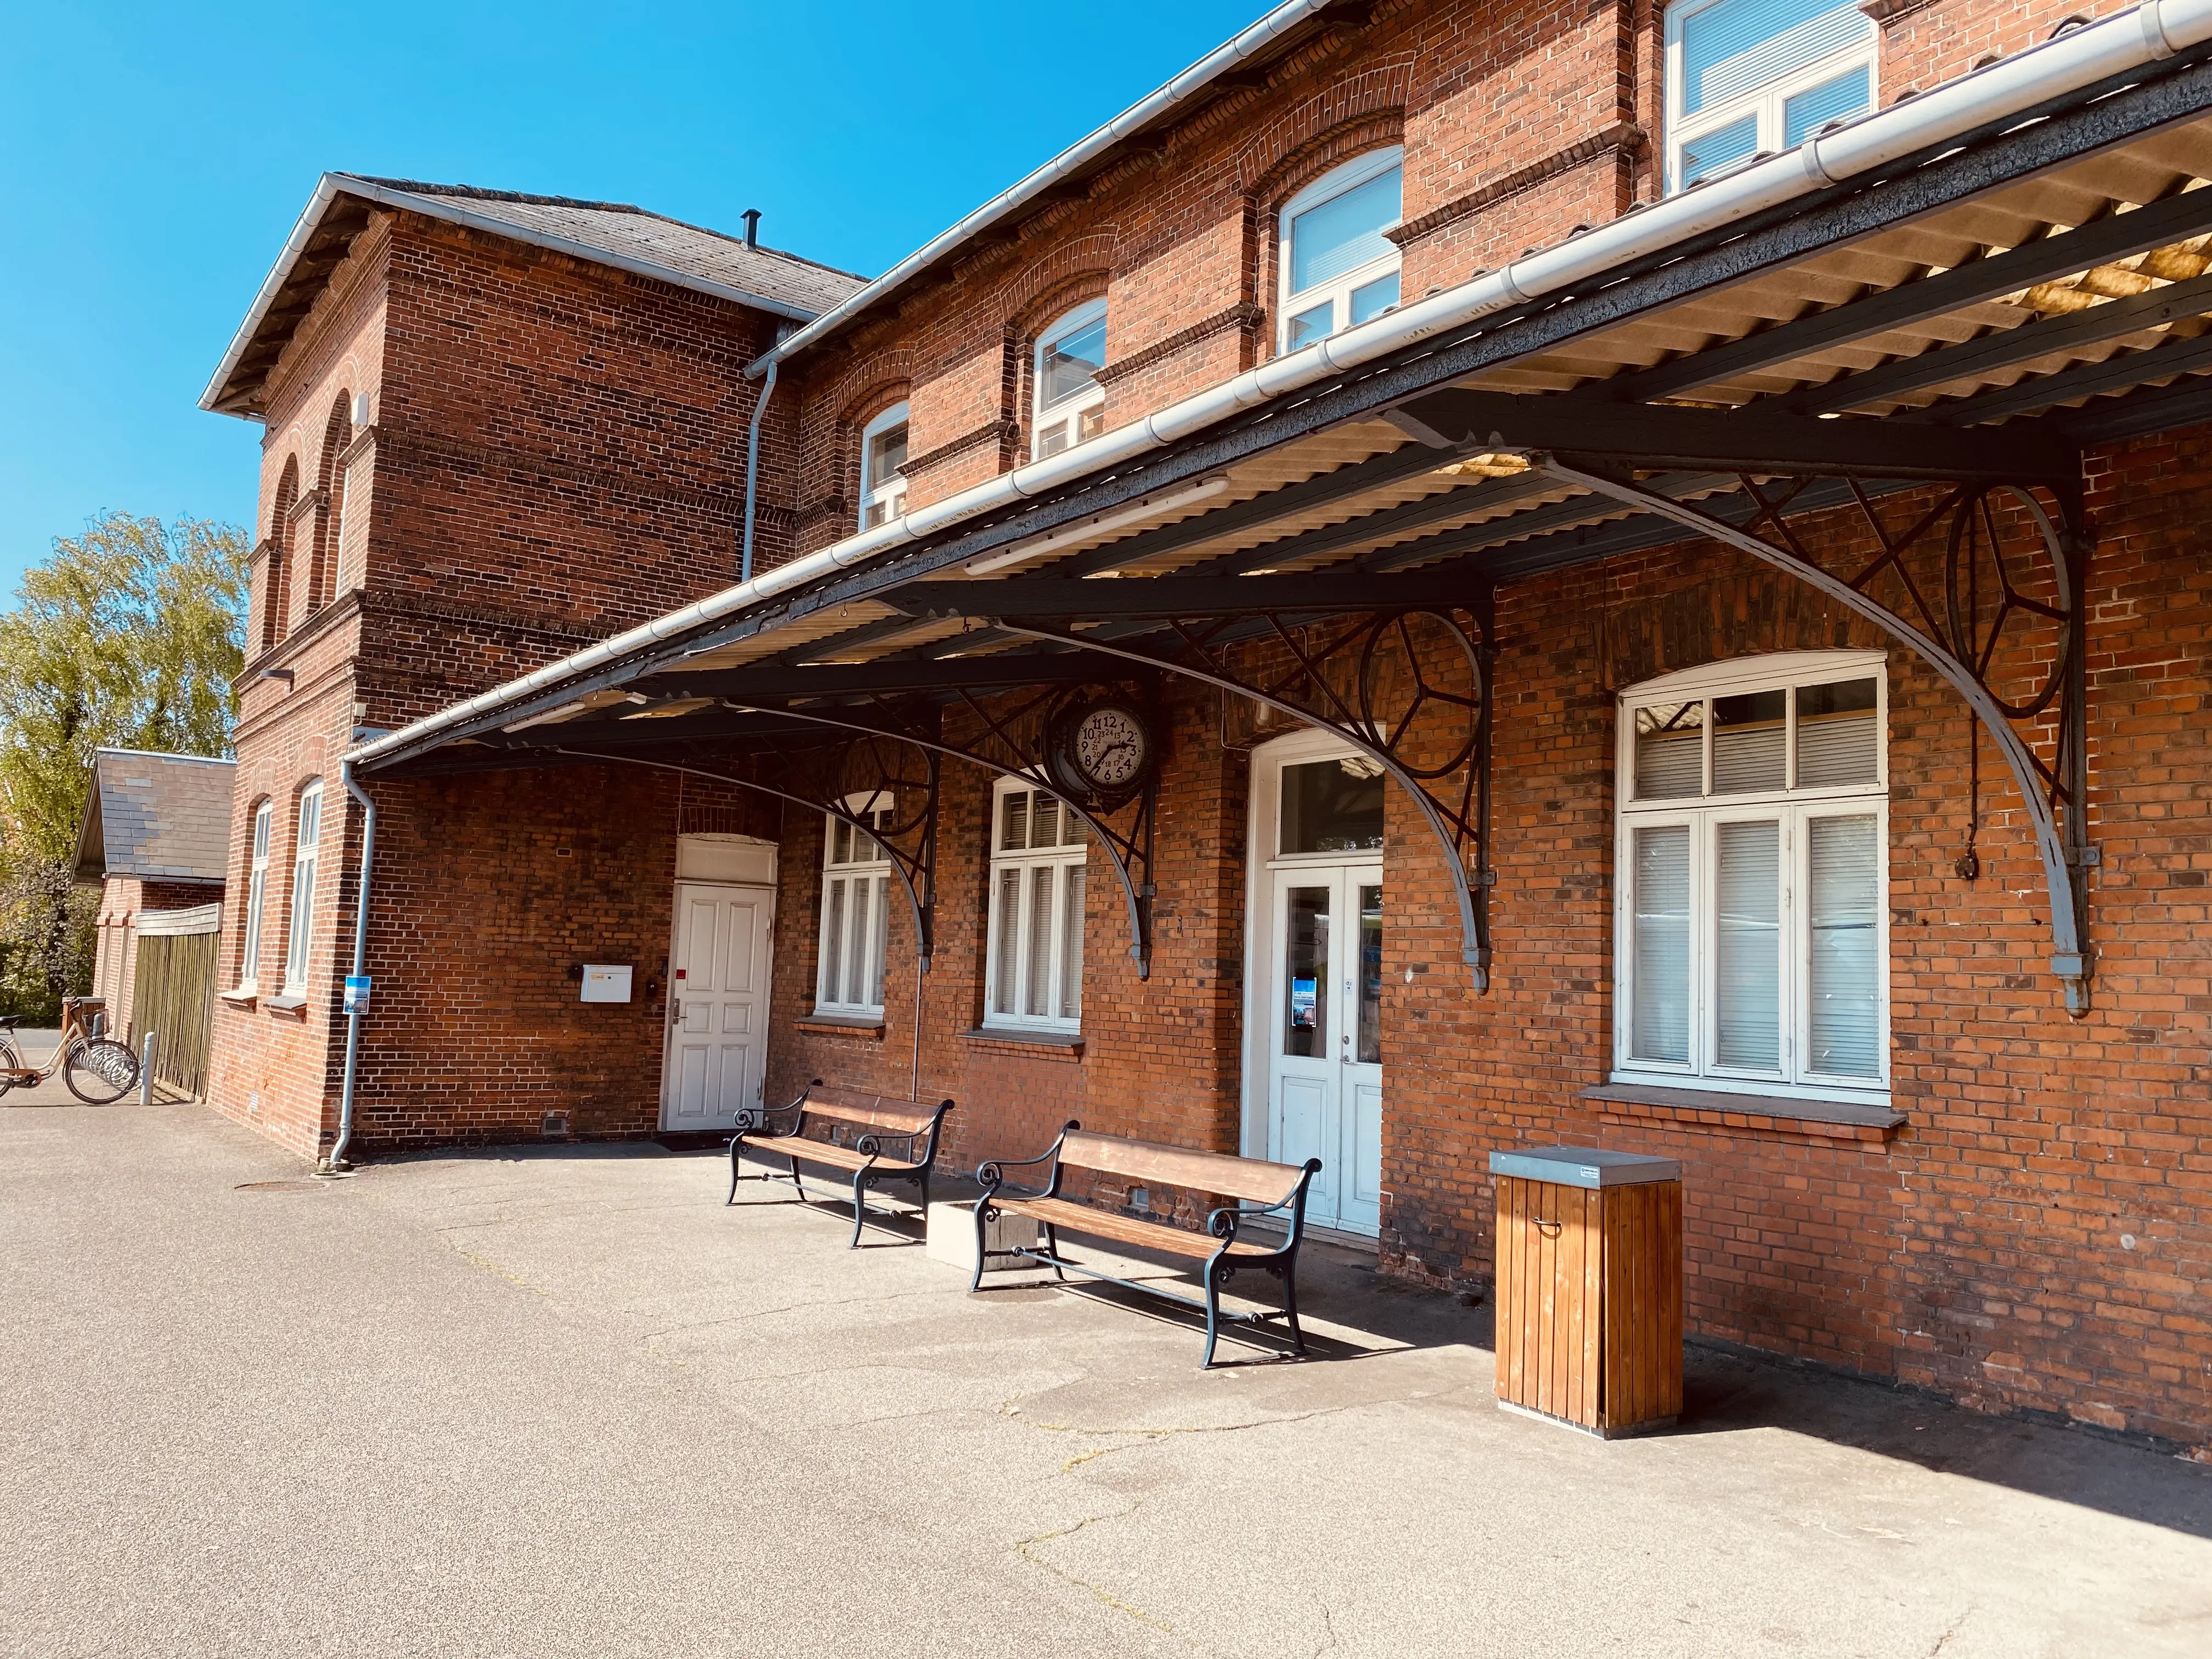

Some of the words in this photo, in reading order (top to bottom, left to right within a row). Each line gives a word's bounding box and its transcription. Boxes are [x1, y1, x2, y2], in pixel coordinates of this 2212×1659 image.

[1092, 718, 1102, 730] 11
[1104, 716, 1117, 729] 12
[1120, 721, 1125, 733] 1
[1084, 727, 1094, 740] 10
[1127, 731, 1135, 742] 2
[1081, 741, 1088, 753] 9
[1130, 745, 1137, 756] 3
[1085, 755, 1091, 766] 8
[1124, 758, 1132, 770] 4
[1094, 766, 1101, 776] 7
[1104, 769, 1111, 780] 6
[1116, 766, 1124, 778] 5
